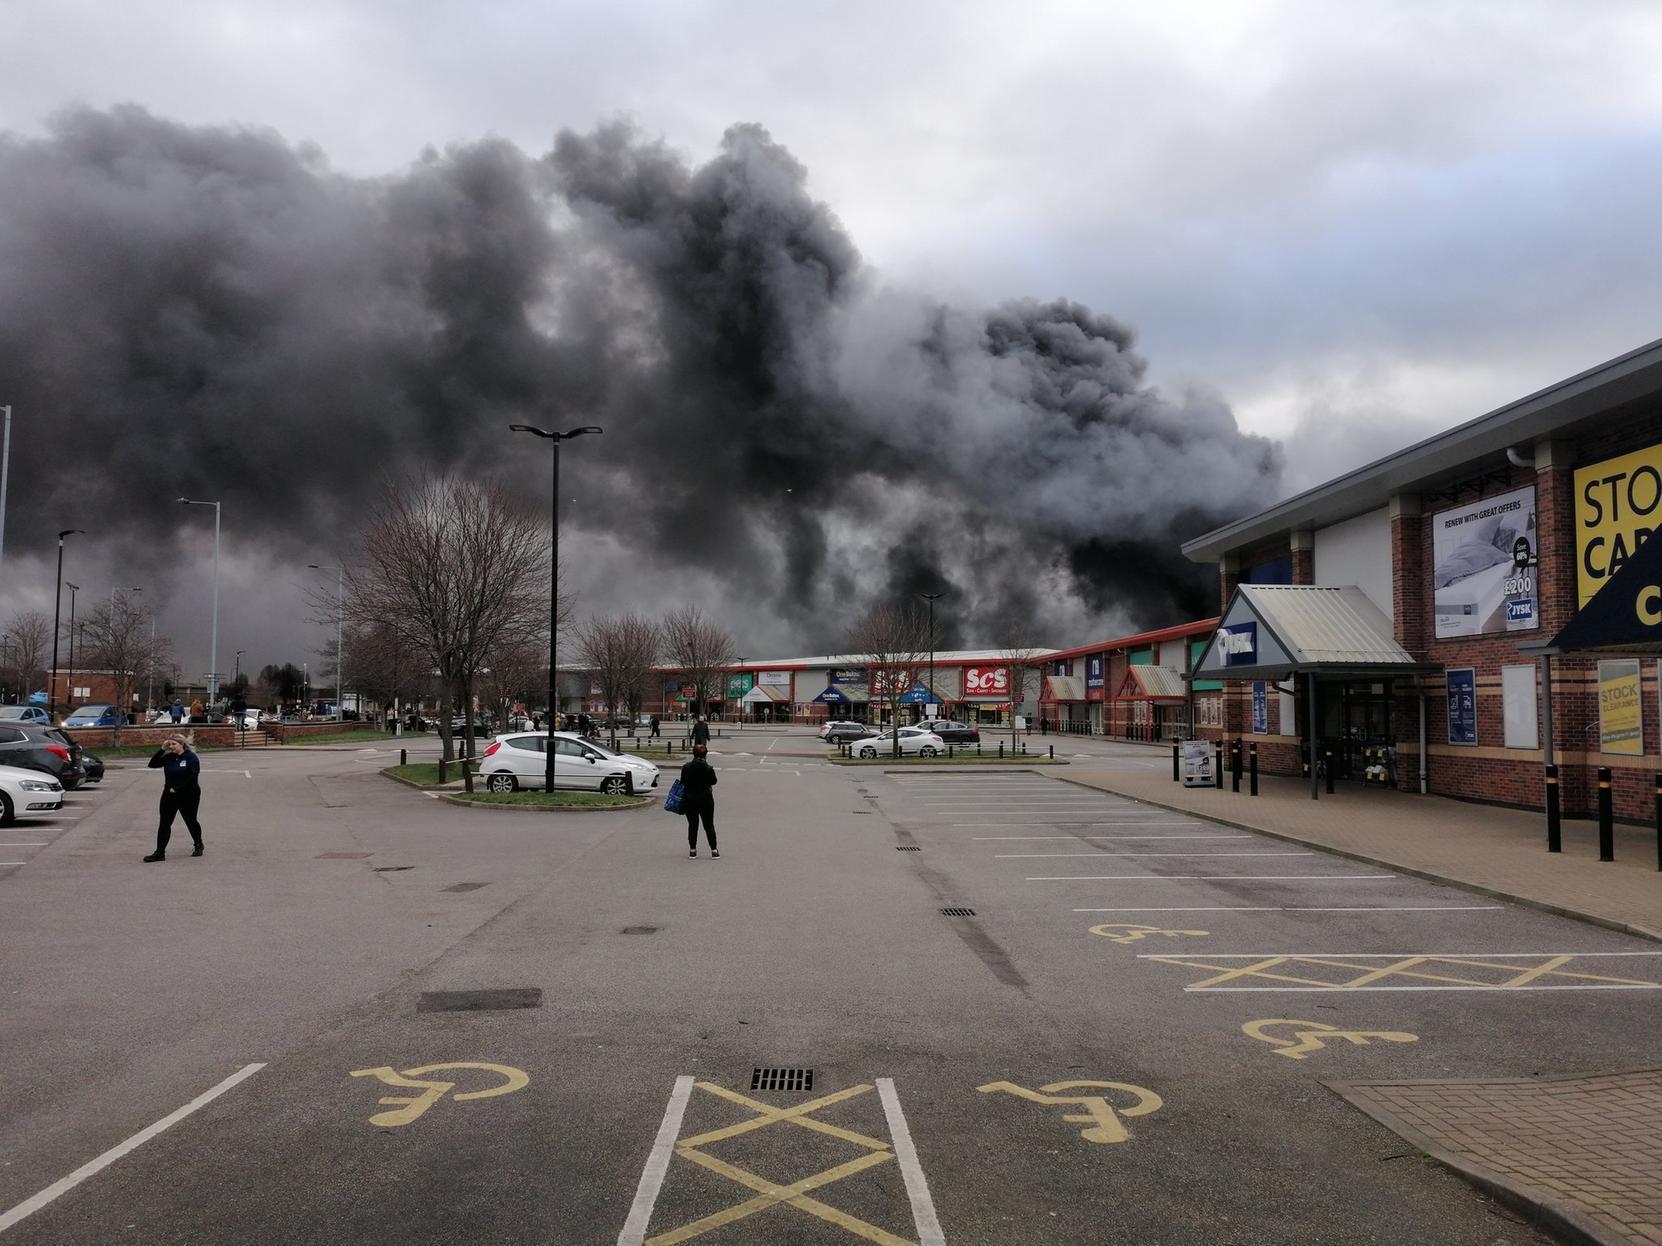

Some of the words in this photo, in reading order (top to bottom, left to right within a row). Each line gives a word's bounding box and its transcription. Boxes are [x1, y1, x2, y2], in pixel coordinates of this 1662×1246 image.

[1445, 517, 1464, 528] RENEW
[1464, 513, 1479, 523] WITH
[1479, 507, 1497, 519] GREAT
[1498, 500, 1521, 514] OFFERS
[1505, 577, 1531, 595] £200
[1511, 603, 1531, 616] JYSK
[1601, 683, 1638, 702] STOCK
